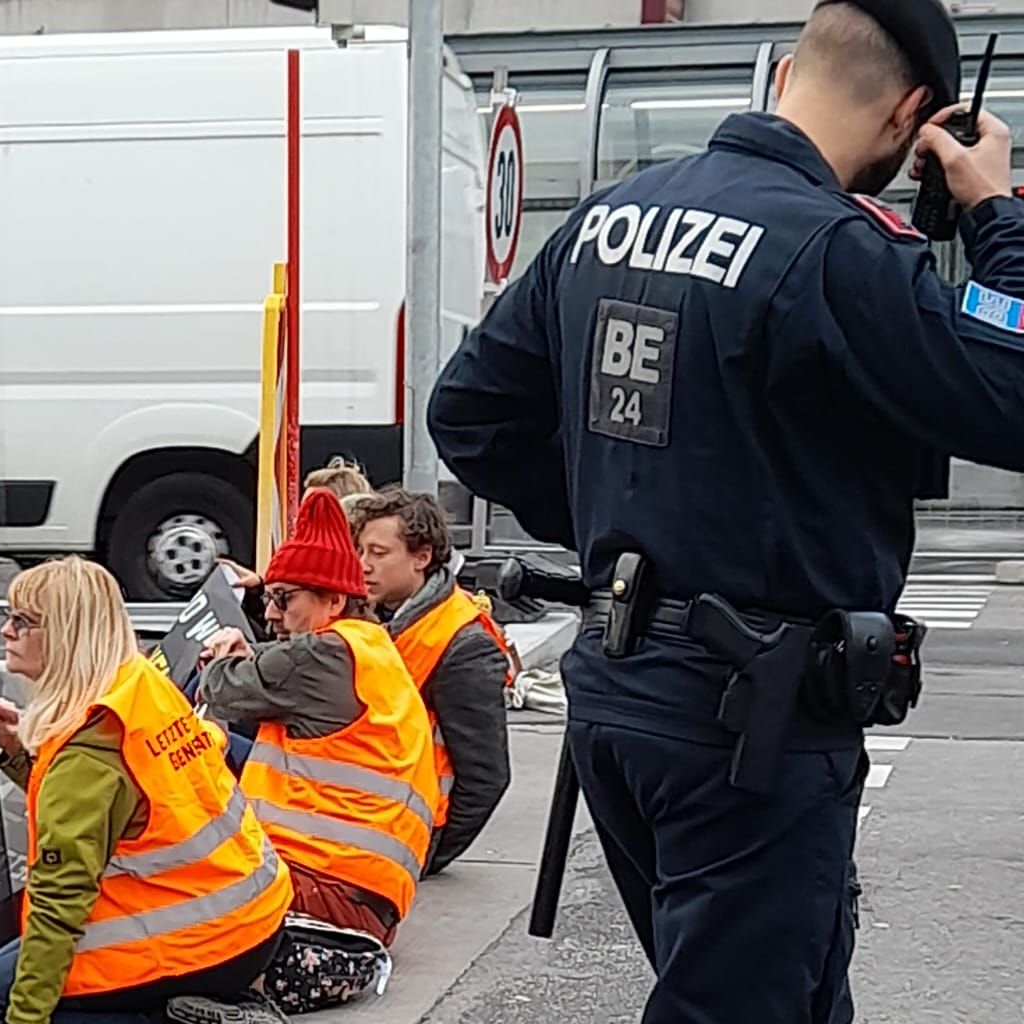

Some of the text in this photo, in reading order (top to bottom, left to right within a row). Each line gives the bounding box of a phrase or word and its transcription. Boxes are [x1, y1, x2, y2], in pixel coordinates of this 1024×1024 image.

[494, 150, 516, 240] 30
[571, 203, 766, 289] POLIZEI
[601, 318, 665, 384] BE
[609, 386, 642, 427] 24
[145, 716, 192, 758] LETZTE
